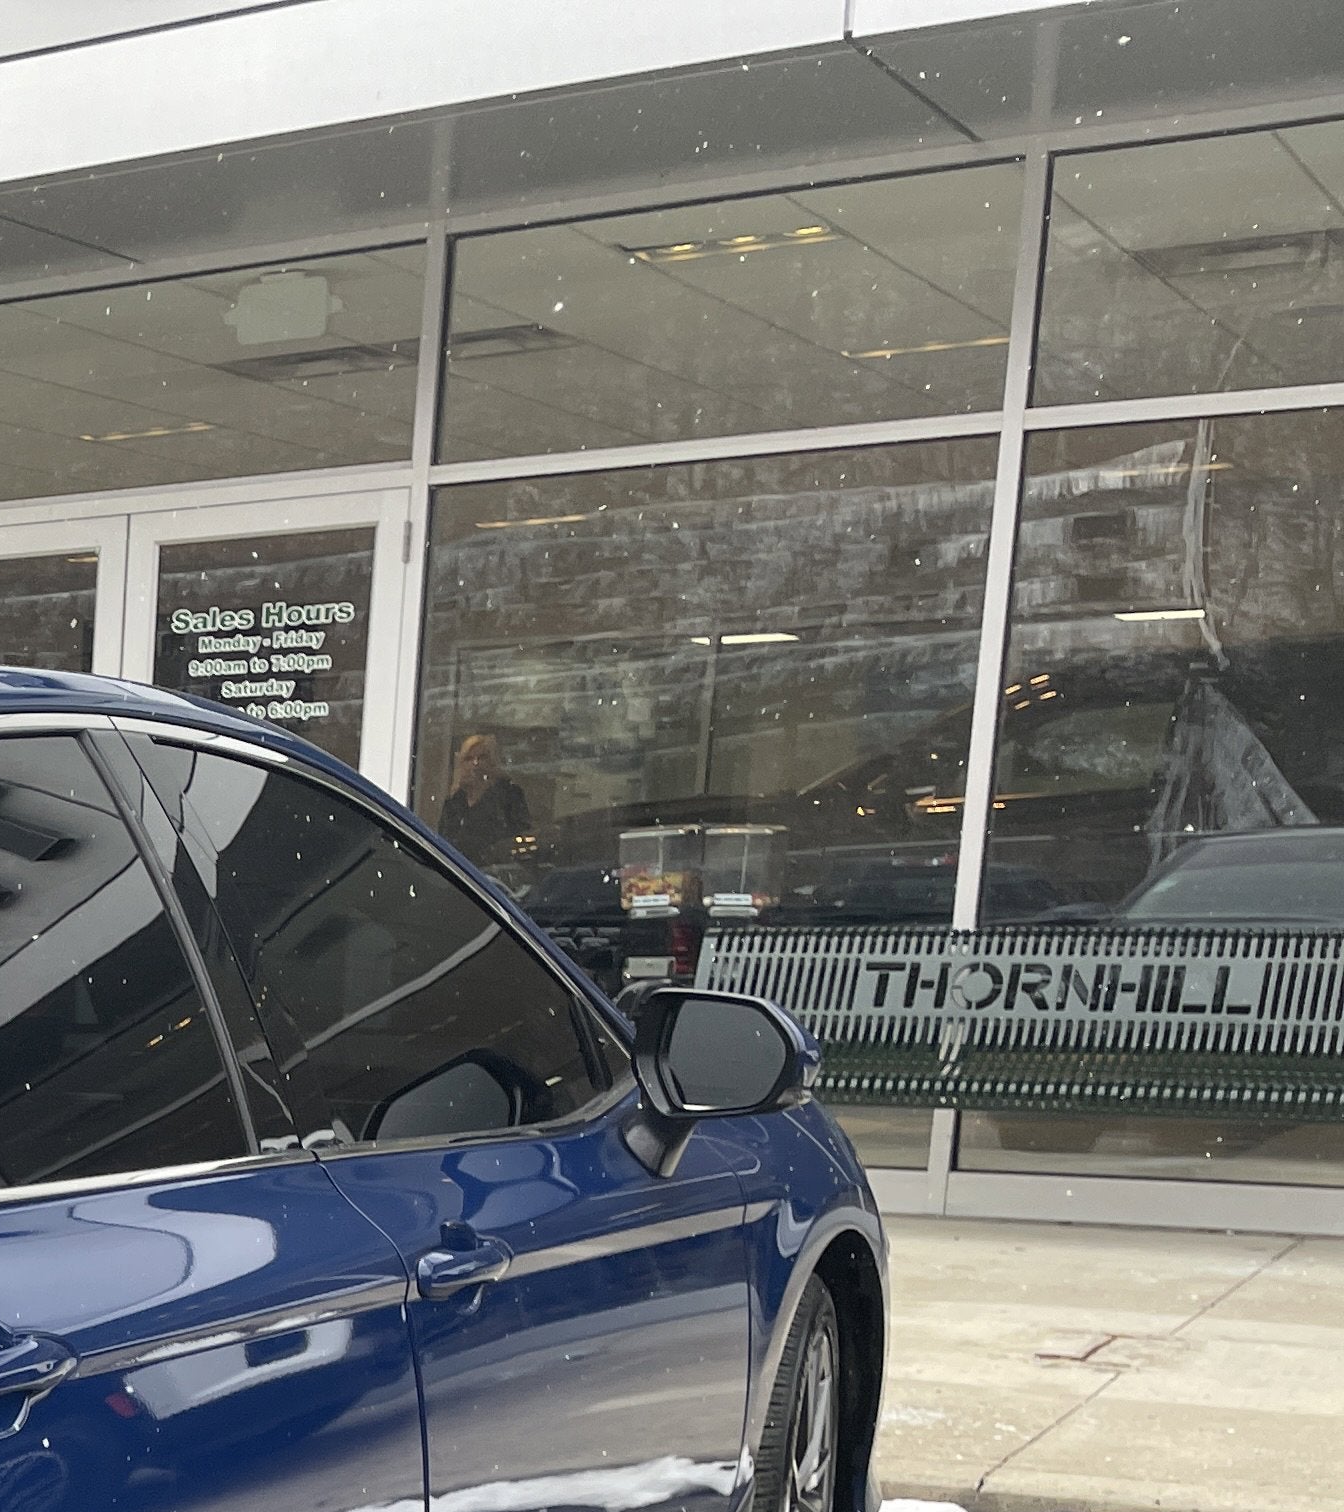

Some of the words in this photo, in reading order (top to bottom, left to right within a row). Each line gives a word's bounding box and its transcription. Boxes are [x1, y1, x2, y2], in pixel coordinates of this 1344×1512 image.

[171, 606, 255, 634] Sales
[262, 601, 355, 628] Hours
[198, 634, 261, 653] Monday
[272, 630, 325, 649] Friday
[188, 659, 248, 677] 9:00am
[250, 657, 269, 673] to
[221, 679, 296, 698] Saturday
[247, 703, 266, 720] to
[268, 701, 329, 720] 6:00pm
[865, 960, 1252, 1016] THORNHILL
